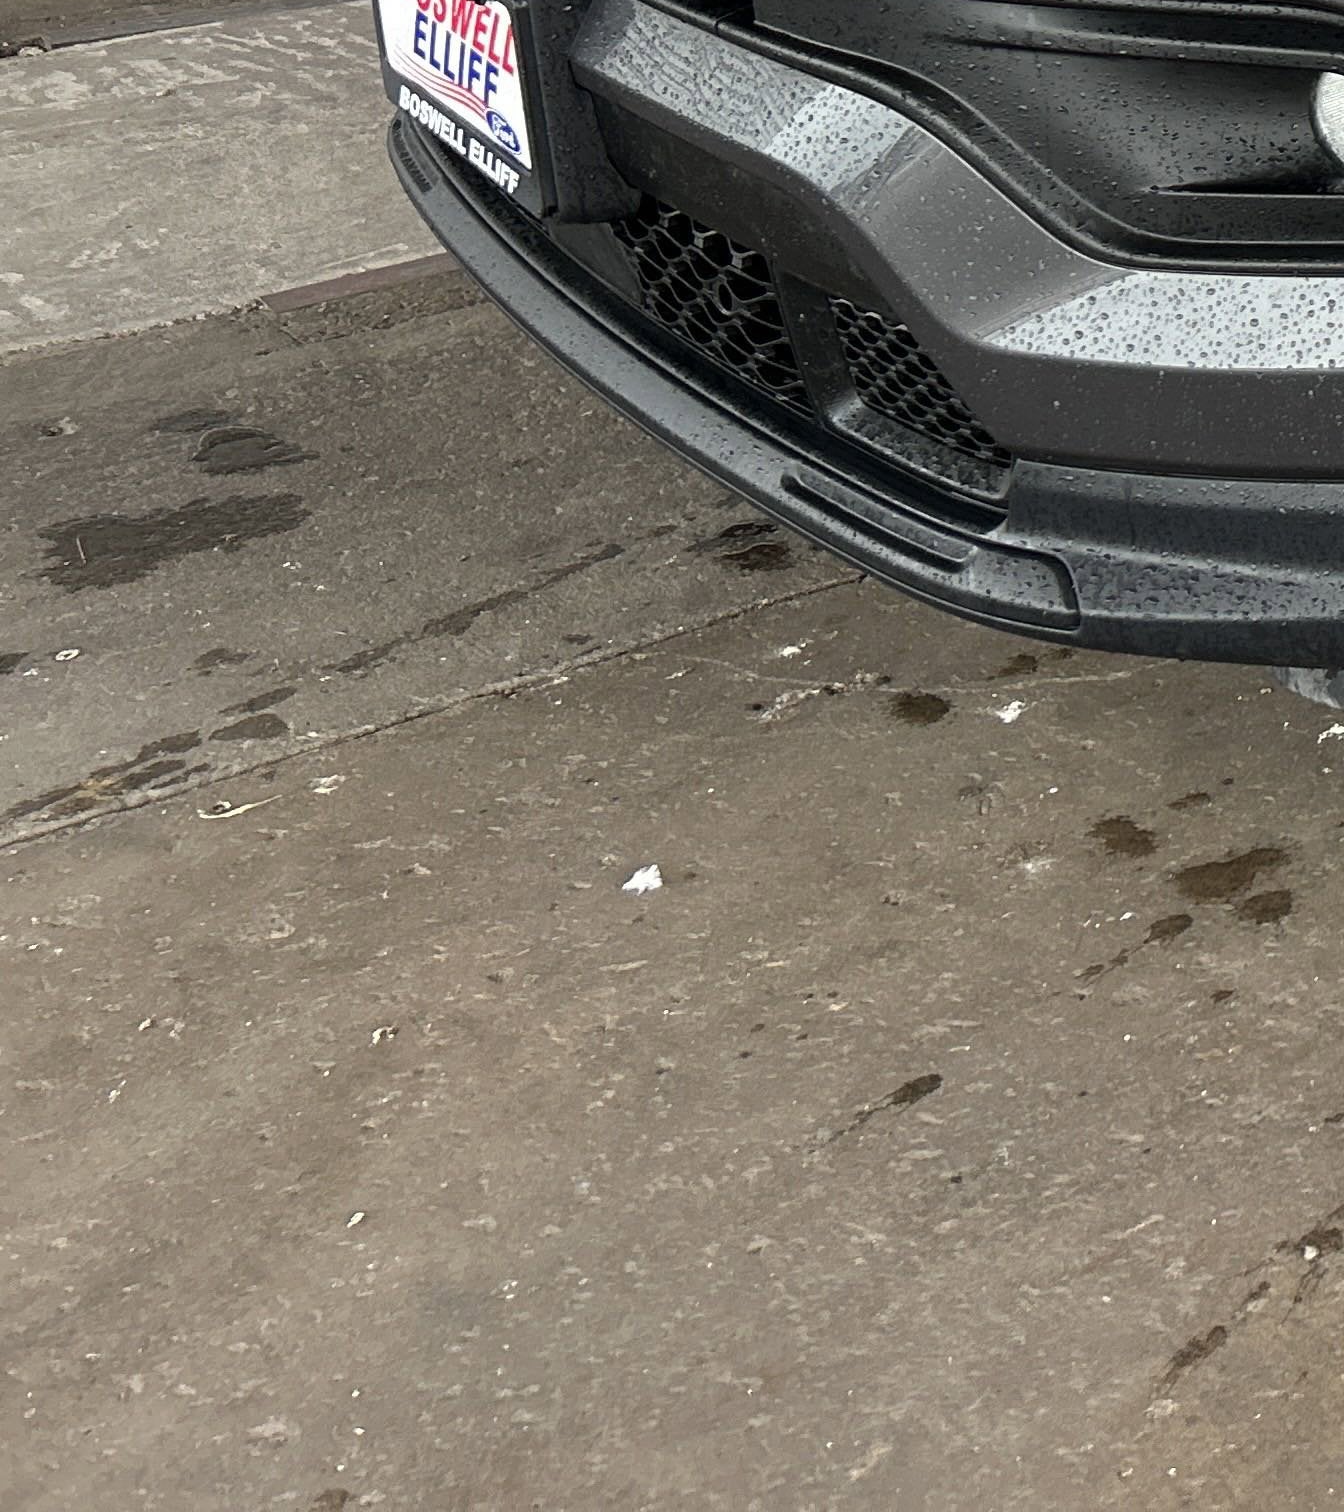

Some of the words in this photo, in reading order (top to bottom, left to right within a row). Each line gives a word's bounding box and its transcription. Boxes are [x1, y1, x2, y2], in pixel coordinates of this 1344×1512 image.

[413, 9, 499, 108] ELLIFF
[399, 85, 466, 156] BOSWELL
[467, 138, 520, 194] ELLIFF
